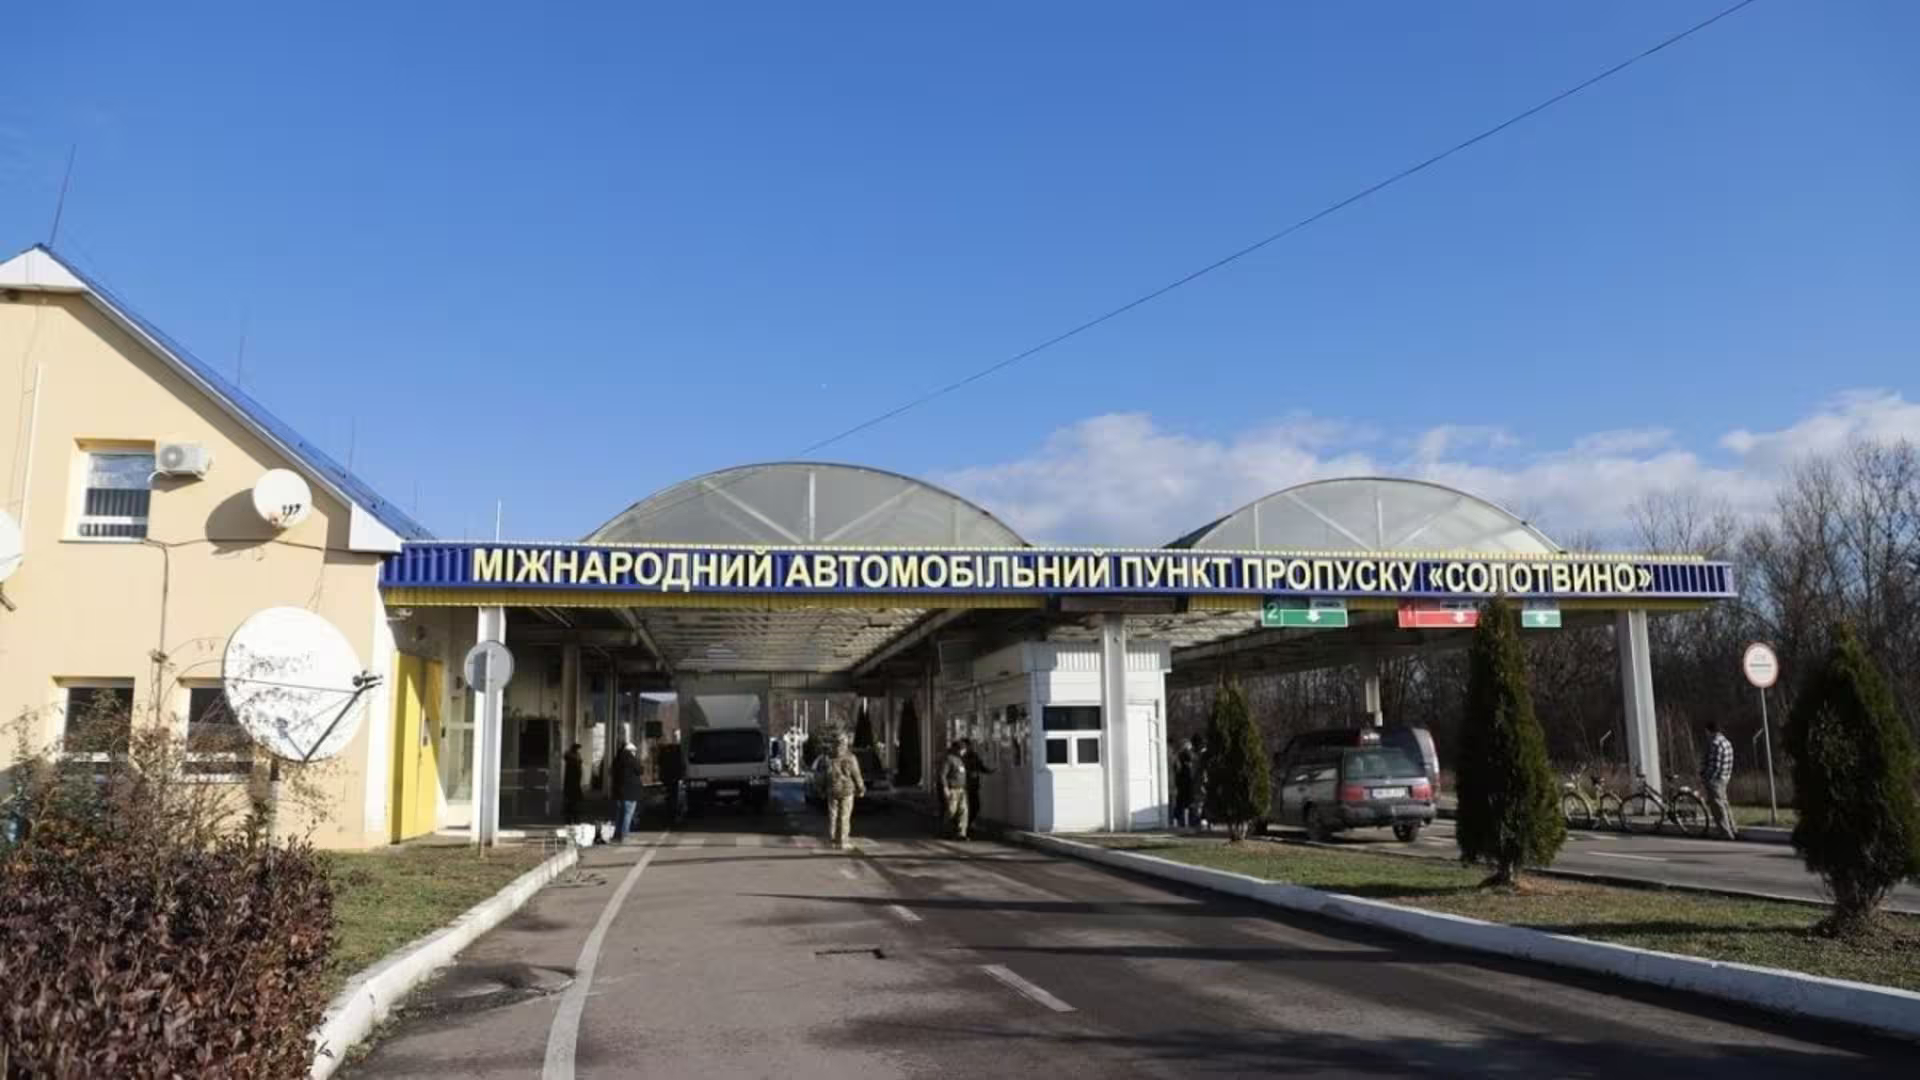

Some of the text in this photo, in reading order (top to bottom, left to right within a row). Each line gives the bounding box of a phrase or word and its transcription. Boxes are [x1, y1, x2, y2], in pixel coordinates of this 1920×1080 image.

[472, 546, 1652, 593] МІЖНАРОДНИЙ АВТОМОБІЛЬНИЙ ПУНКТ ПРОПУСКУ «СОЛОТВИНО»
[1267, 603, 1279, 619] 2
